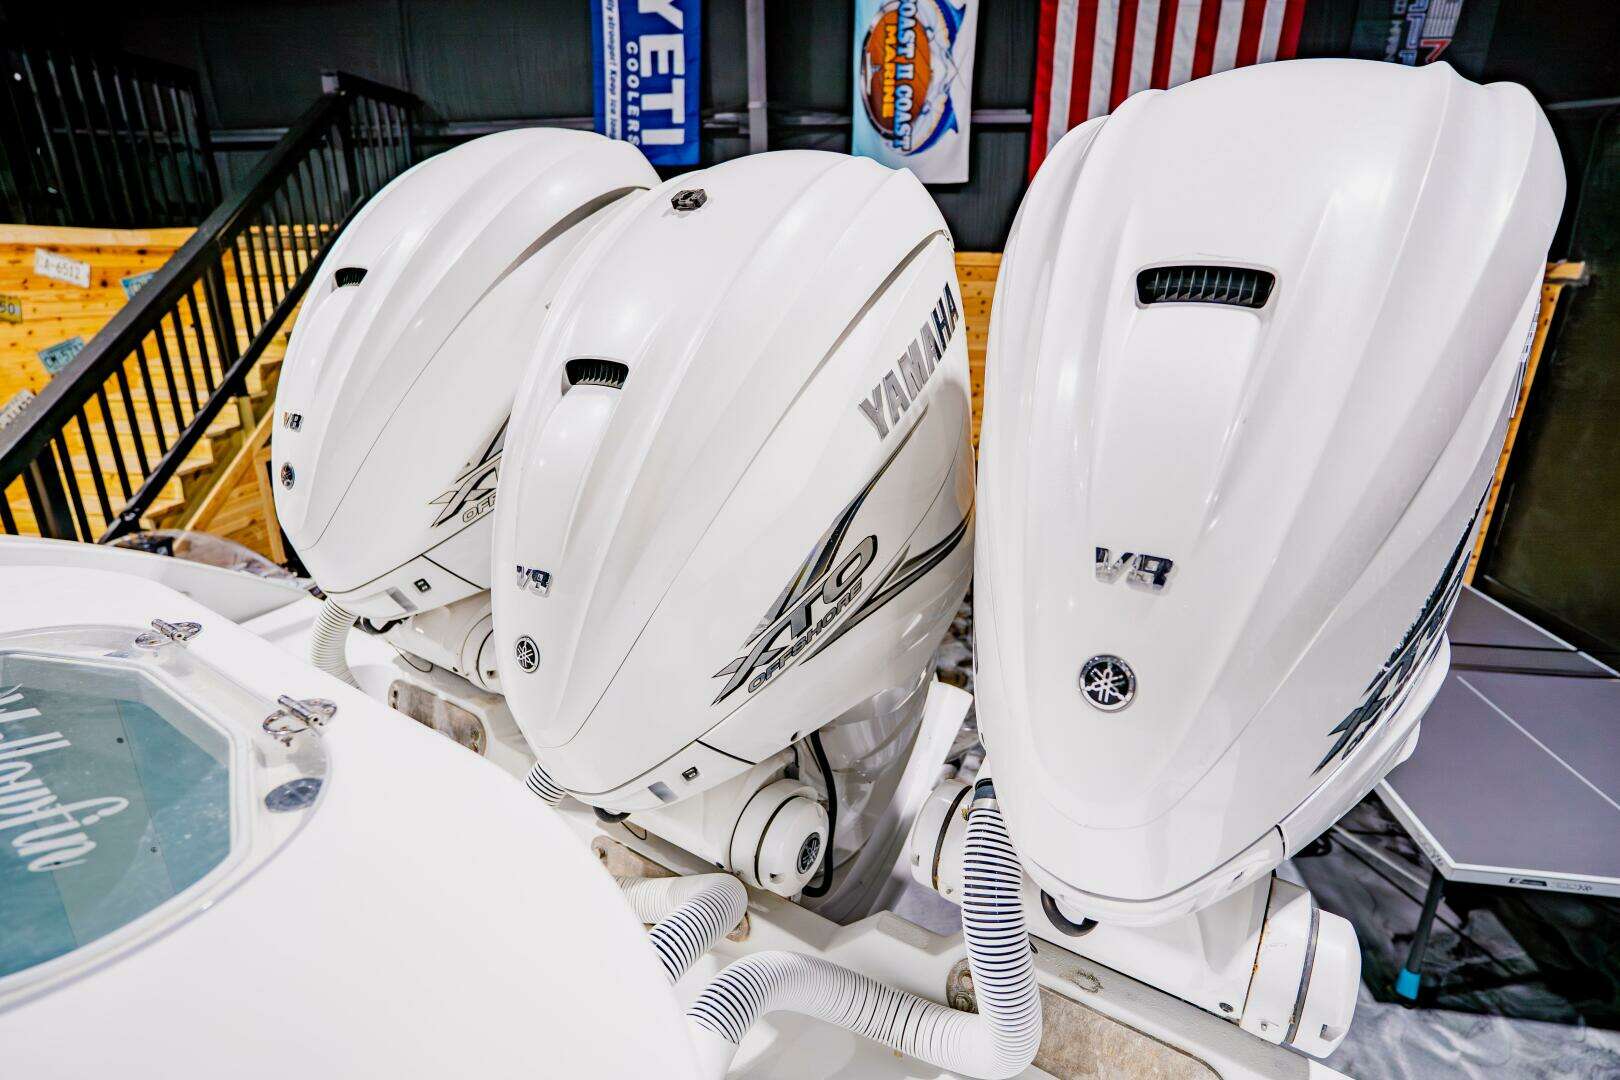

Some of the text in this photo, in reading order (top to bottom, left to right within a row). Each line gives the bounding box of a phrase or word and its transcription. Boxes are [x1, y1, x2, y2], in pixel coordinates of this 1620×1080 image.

[638, 0, 685, 145] YETI
[882, 25, 898, 118] MARINE
[897, 0, 917, 59] OAST
[626, 41, 640, 147] COOLERS
[892, 84, 914, 152] COAST
[858, 281, 960, 442] YAMAHA
[711, 535, 878, 706] XTO
[1095, 546, 1174, 593] V8
[747, 577, 863, 694] OFFSHORE
